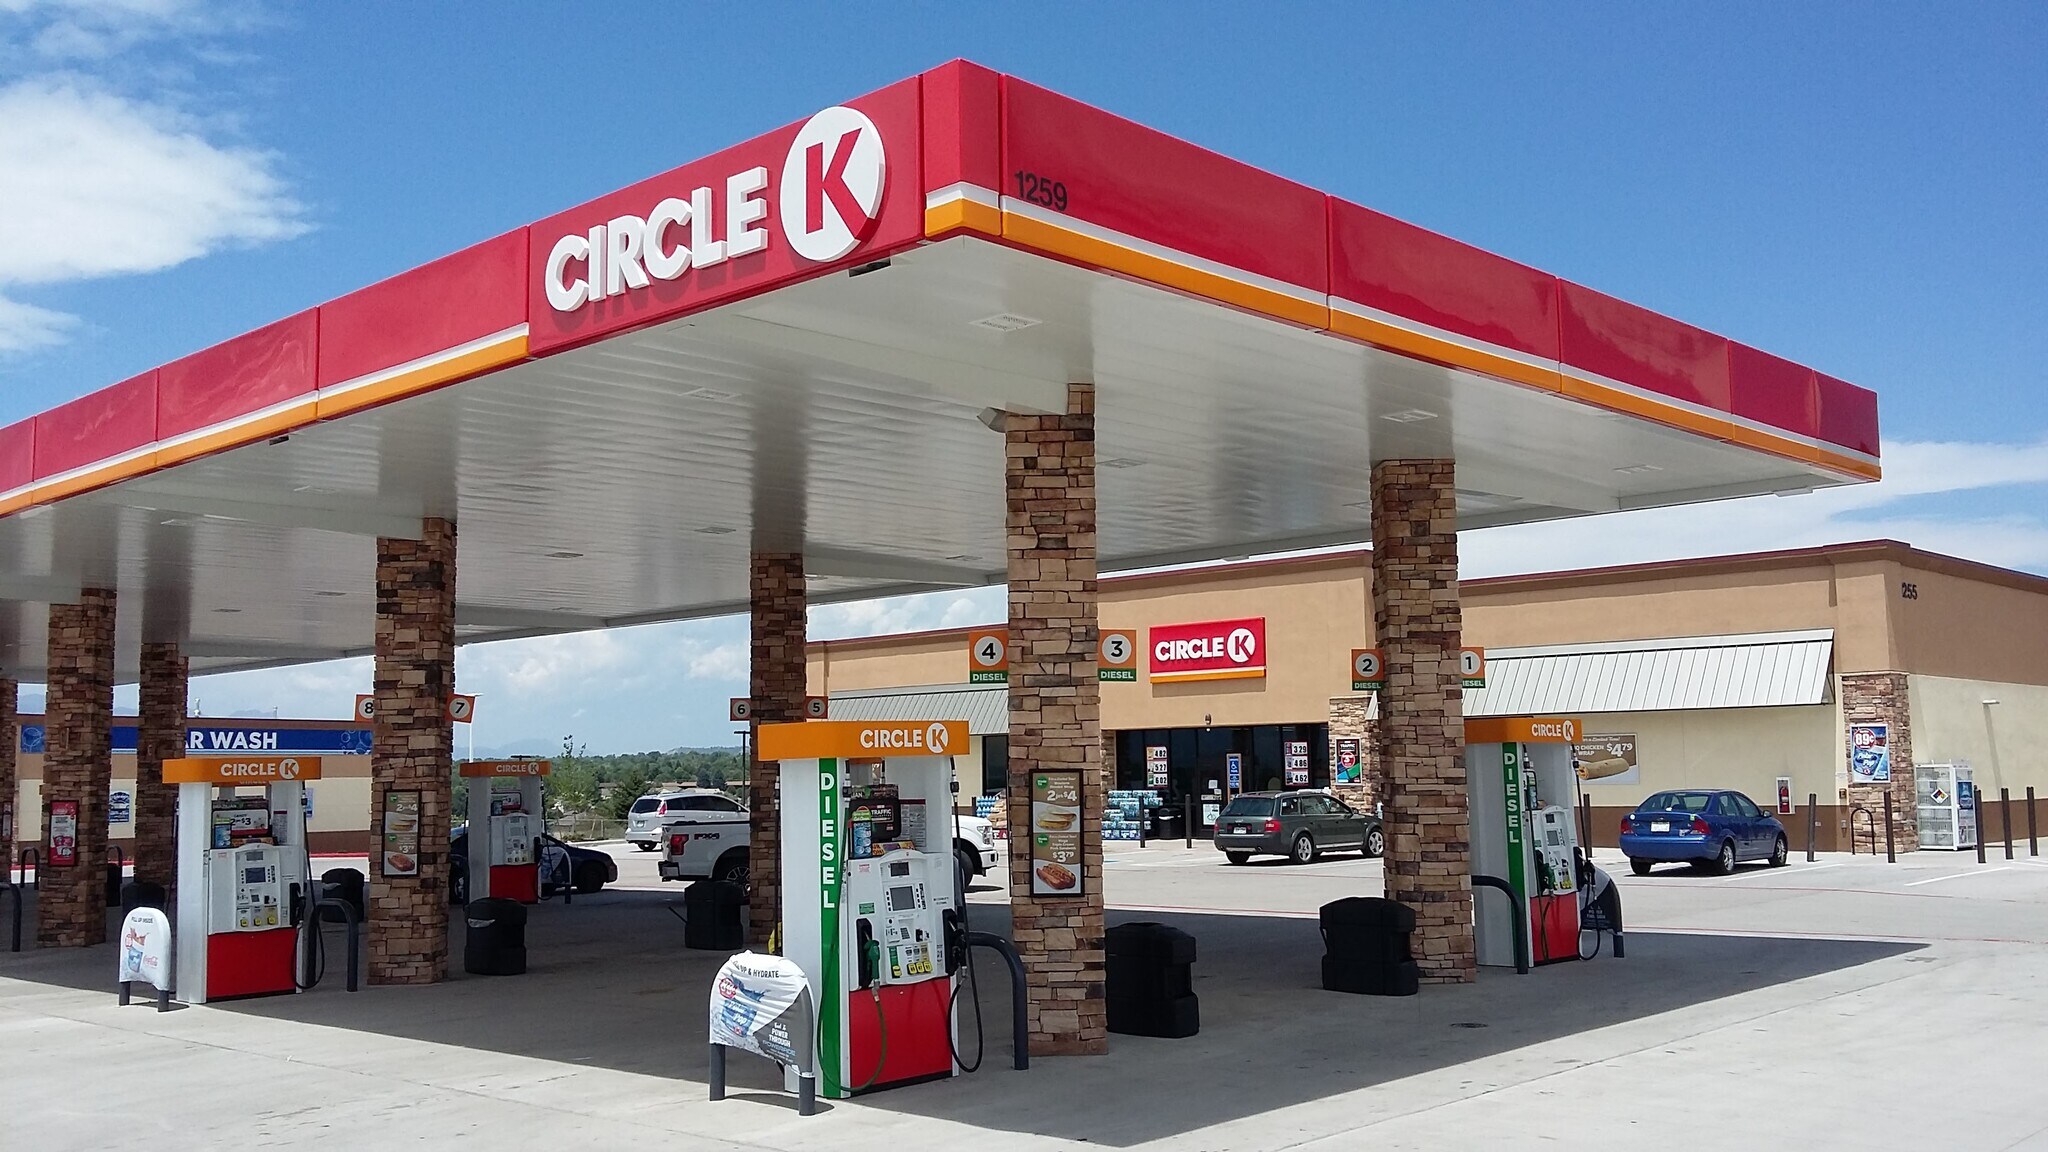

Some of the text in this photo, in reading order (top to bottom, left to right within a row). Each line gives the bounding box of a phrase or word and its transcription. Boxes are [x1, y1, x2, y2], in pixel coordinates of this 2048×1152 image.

[1014, 170, 1068, 211] 1259
[545, 166, 768, 312] CIRCLE
[982, 642, 996, 660] 4
[1110, 640, 1123, 658] 3
[1155, 637, 1224, 661] CIRCLE
[1362, 658, 1373, 672] 2
[1465, 656, 1472, 670] 1
[972, 673, 1006, 682] DIESEL
[1100, 671, 1134, 680] DIESEL
[364, 702, 374, 714] 8
[455, 702, 465, 714] 7
[738, 704, 746, 715] 6
[812, 702, 821, 713] 5
[1531, 724, 1562, 737] CIRCLE
[209, 731, 278, 750] WASH
[860, 729, 922, 748] CIRCLE
[220, 763, 276, 776] CIRCLE
[496, 764, 527, 773] CIRCLE
[1047, 790, 1056, 801] 2
[1064, 790, 1077, 801] $4
[1504, 752, 1519, 844] DIESEL
[396, 804, 403, 812] 2
[820, 772, 835, 908] DIESEL
[752, 969, 779, 978] HYDRATE
[769, 1034, 791, 1048] THROUGH
